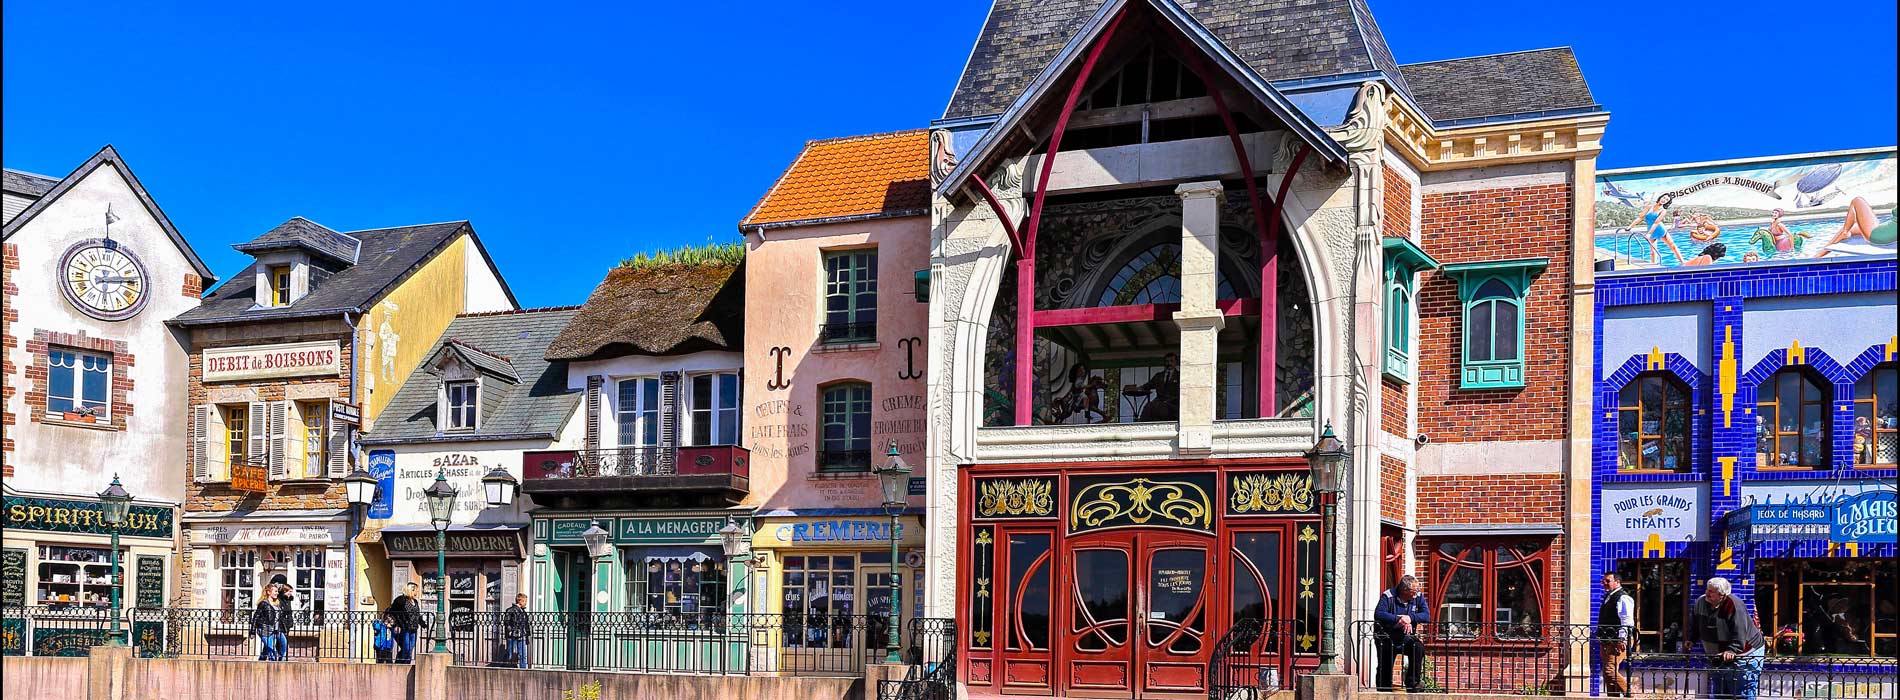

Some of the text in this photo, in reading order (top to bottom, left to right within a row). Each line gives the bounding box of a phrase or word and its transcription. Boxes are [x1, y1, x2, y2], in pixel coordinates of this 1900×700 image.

[1670, 177, 1720, 199] BISCUITERIE
[209, 350, 333, 373] DEBIT de BOISSONS
[793, 404, 803, 416] &
[751, 423, 809, 438] LAIT FRAIS
[875, 420, 912, 434] FROMAGE
[432, 453, 479, 467] BAZAR
[398, 467, 434, 479] ARTICLES
[1613, 494, 1693, 514] POUR LES GRANDS
[1757, 510, 1775, 520] JEUX
[1778, 509, 1789, 519] DE
[1792, 509, 1825, 520] HASARD
[557, 522, 586, 530] CADEAUX
[626, 521, 721, 534] A LA MENAGERE
[1625, 517, 1681, 529] ENFANTS
[308, 532, 329, 540] PATRON
[451, 535, 514, 551] MODERNE
[327, 559, 343, 569] VENTE
